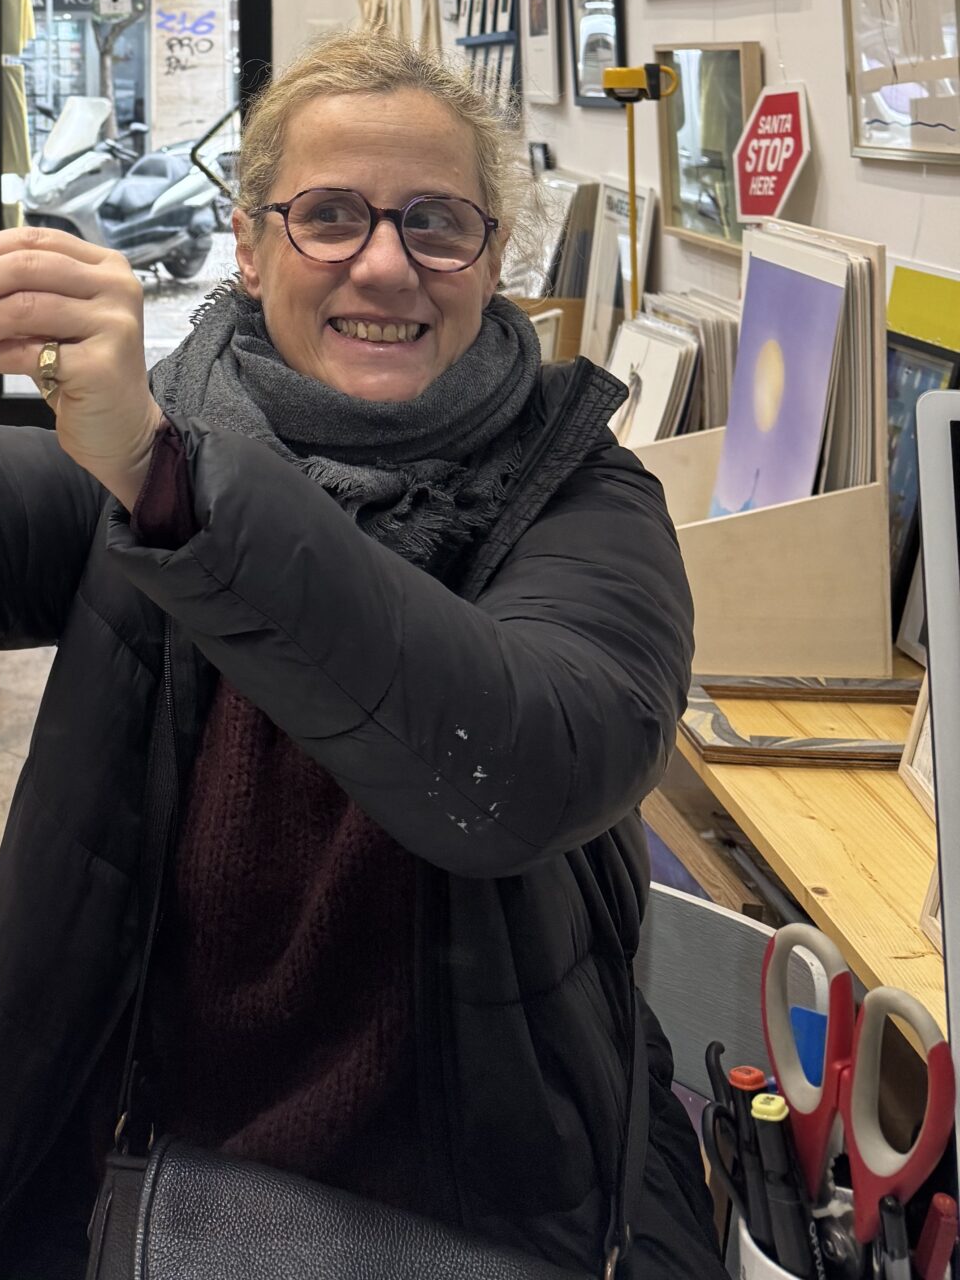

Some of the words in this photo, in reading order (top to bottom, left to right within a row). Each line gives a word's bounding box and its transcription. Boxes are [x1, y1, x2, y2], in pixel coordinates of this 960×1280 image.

[757, 113, 792, 135] SANTA
[745, 136, 795, 174] STOP
[748, 175, 778, 197] HERE
